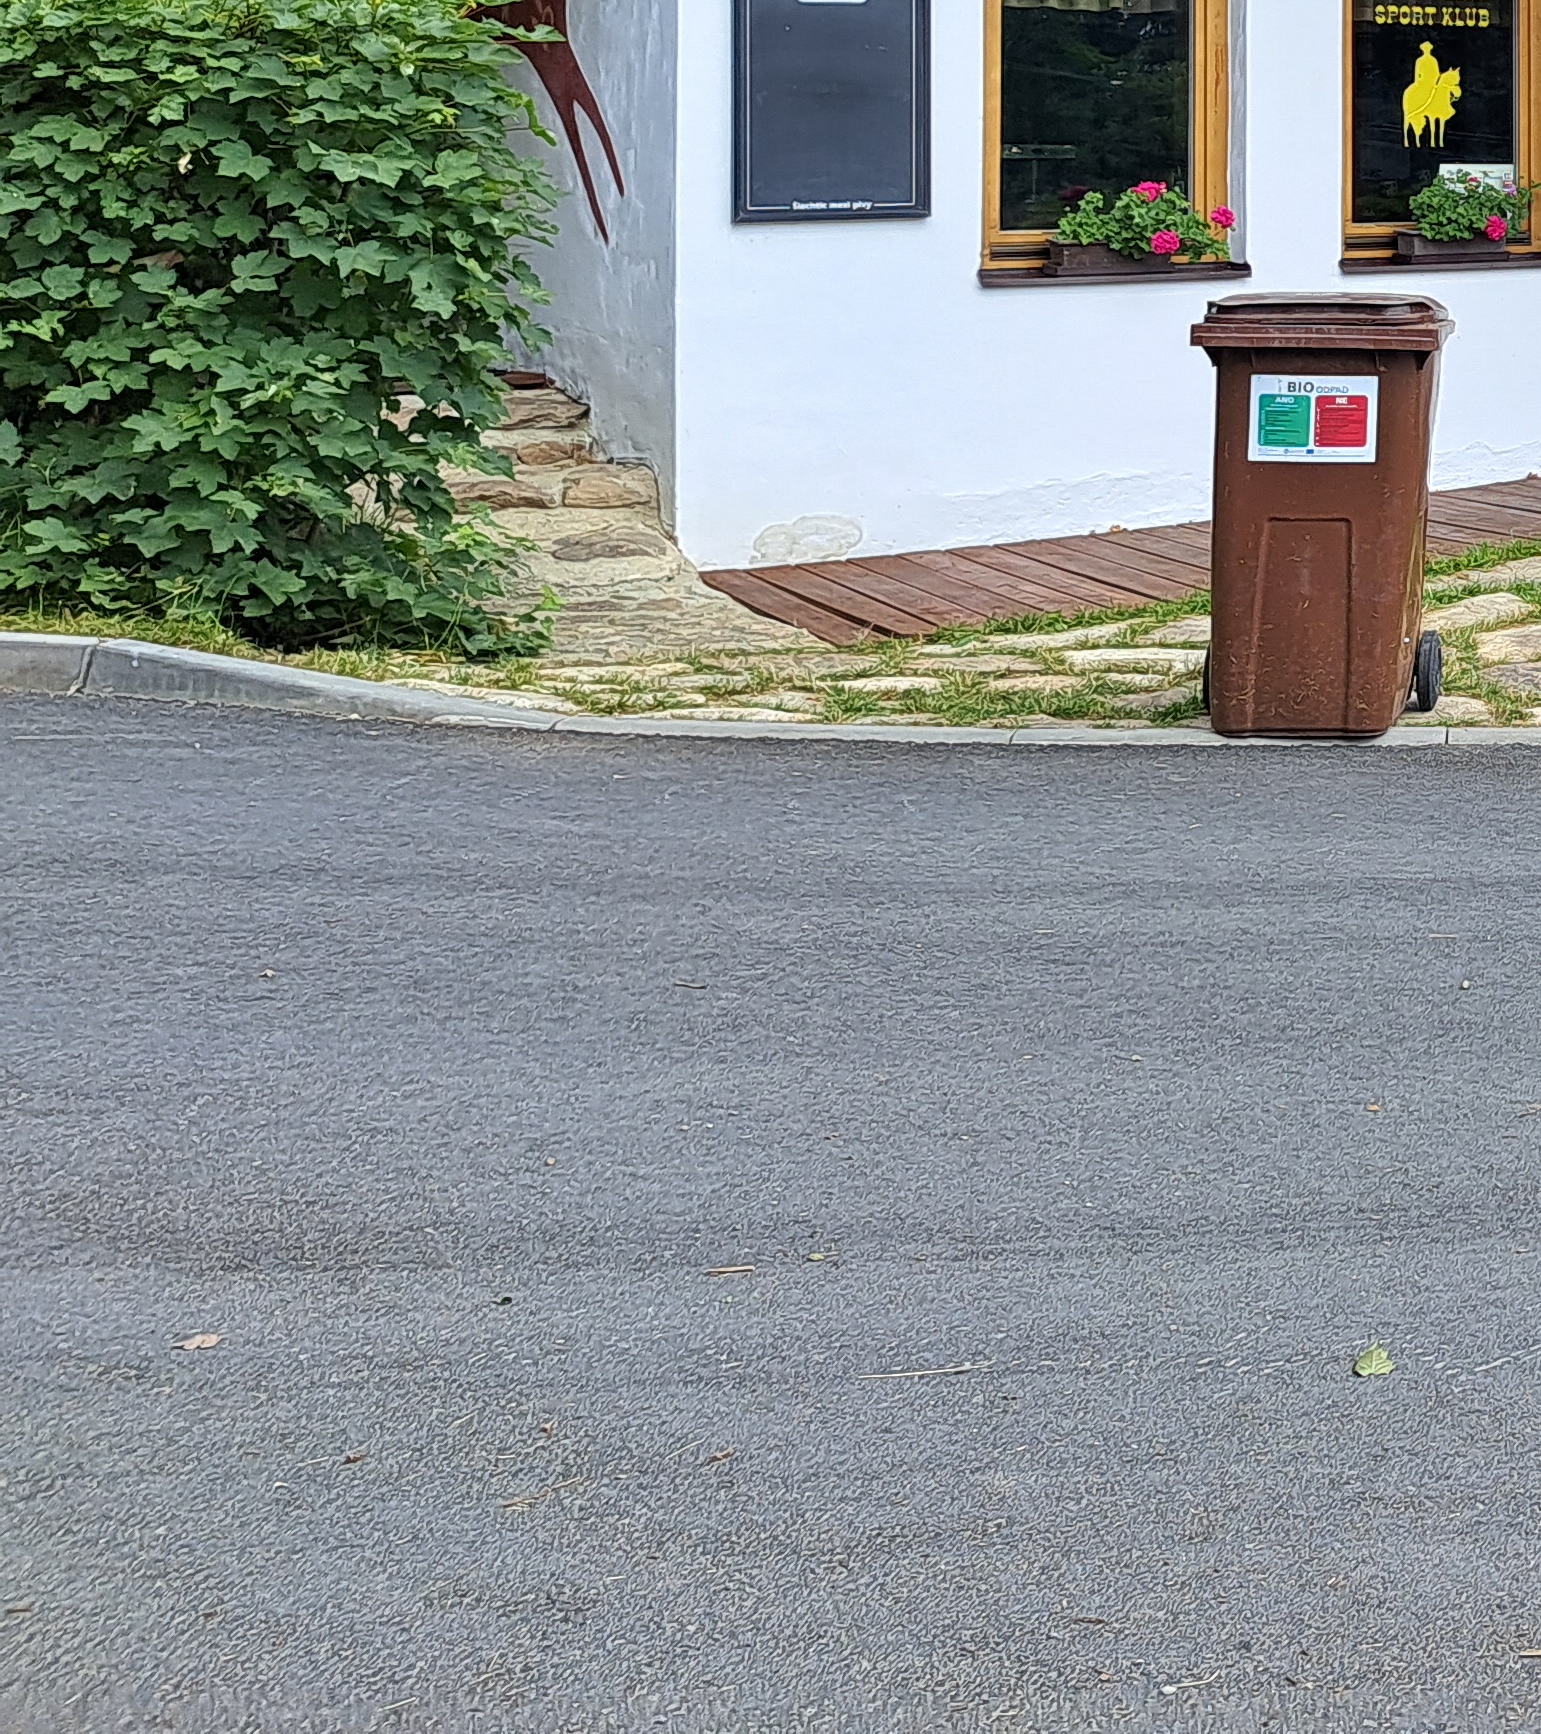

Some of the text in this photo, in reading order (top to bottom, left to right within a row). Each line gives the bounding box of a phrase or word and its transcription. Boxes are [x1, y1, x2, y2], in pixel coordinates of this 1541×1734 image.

[1374, 4, 1491, 28] SPORT KLUB
[1287, 382, 1314, 393] BIO
